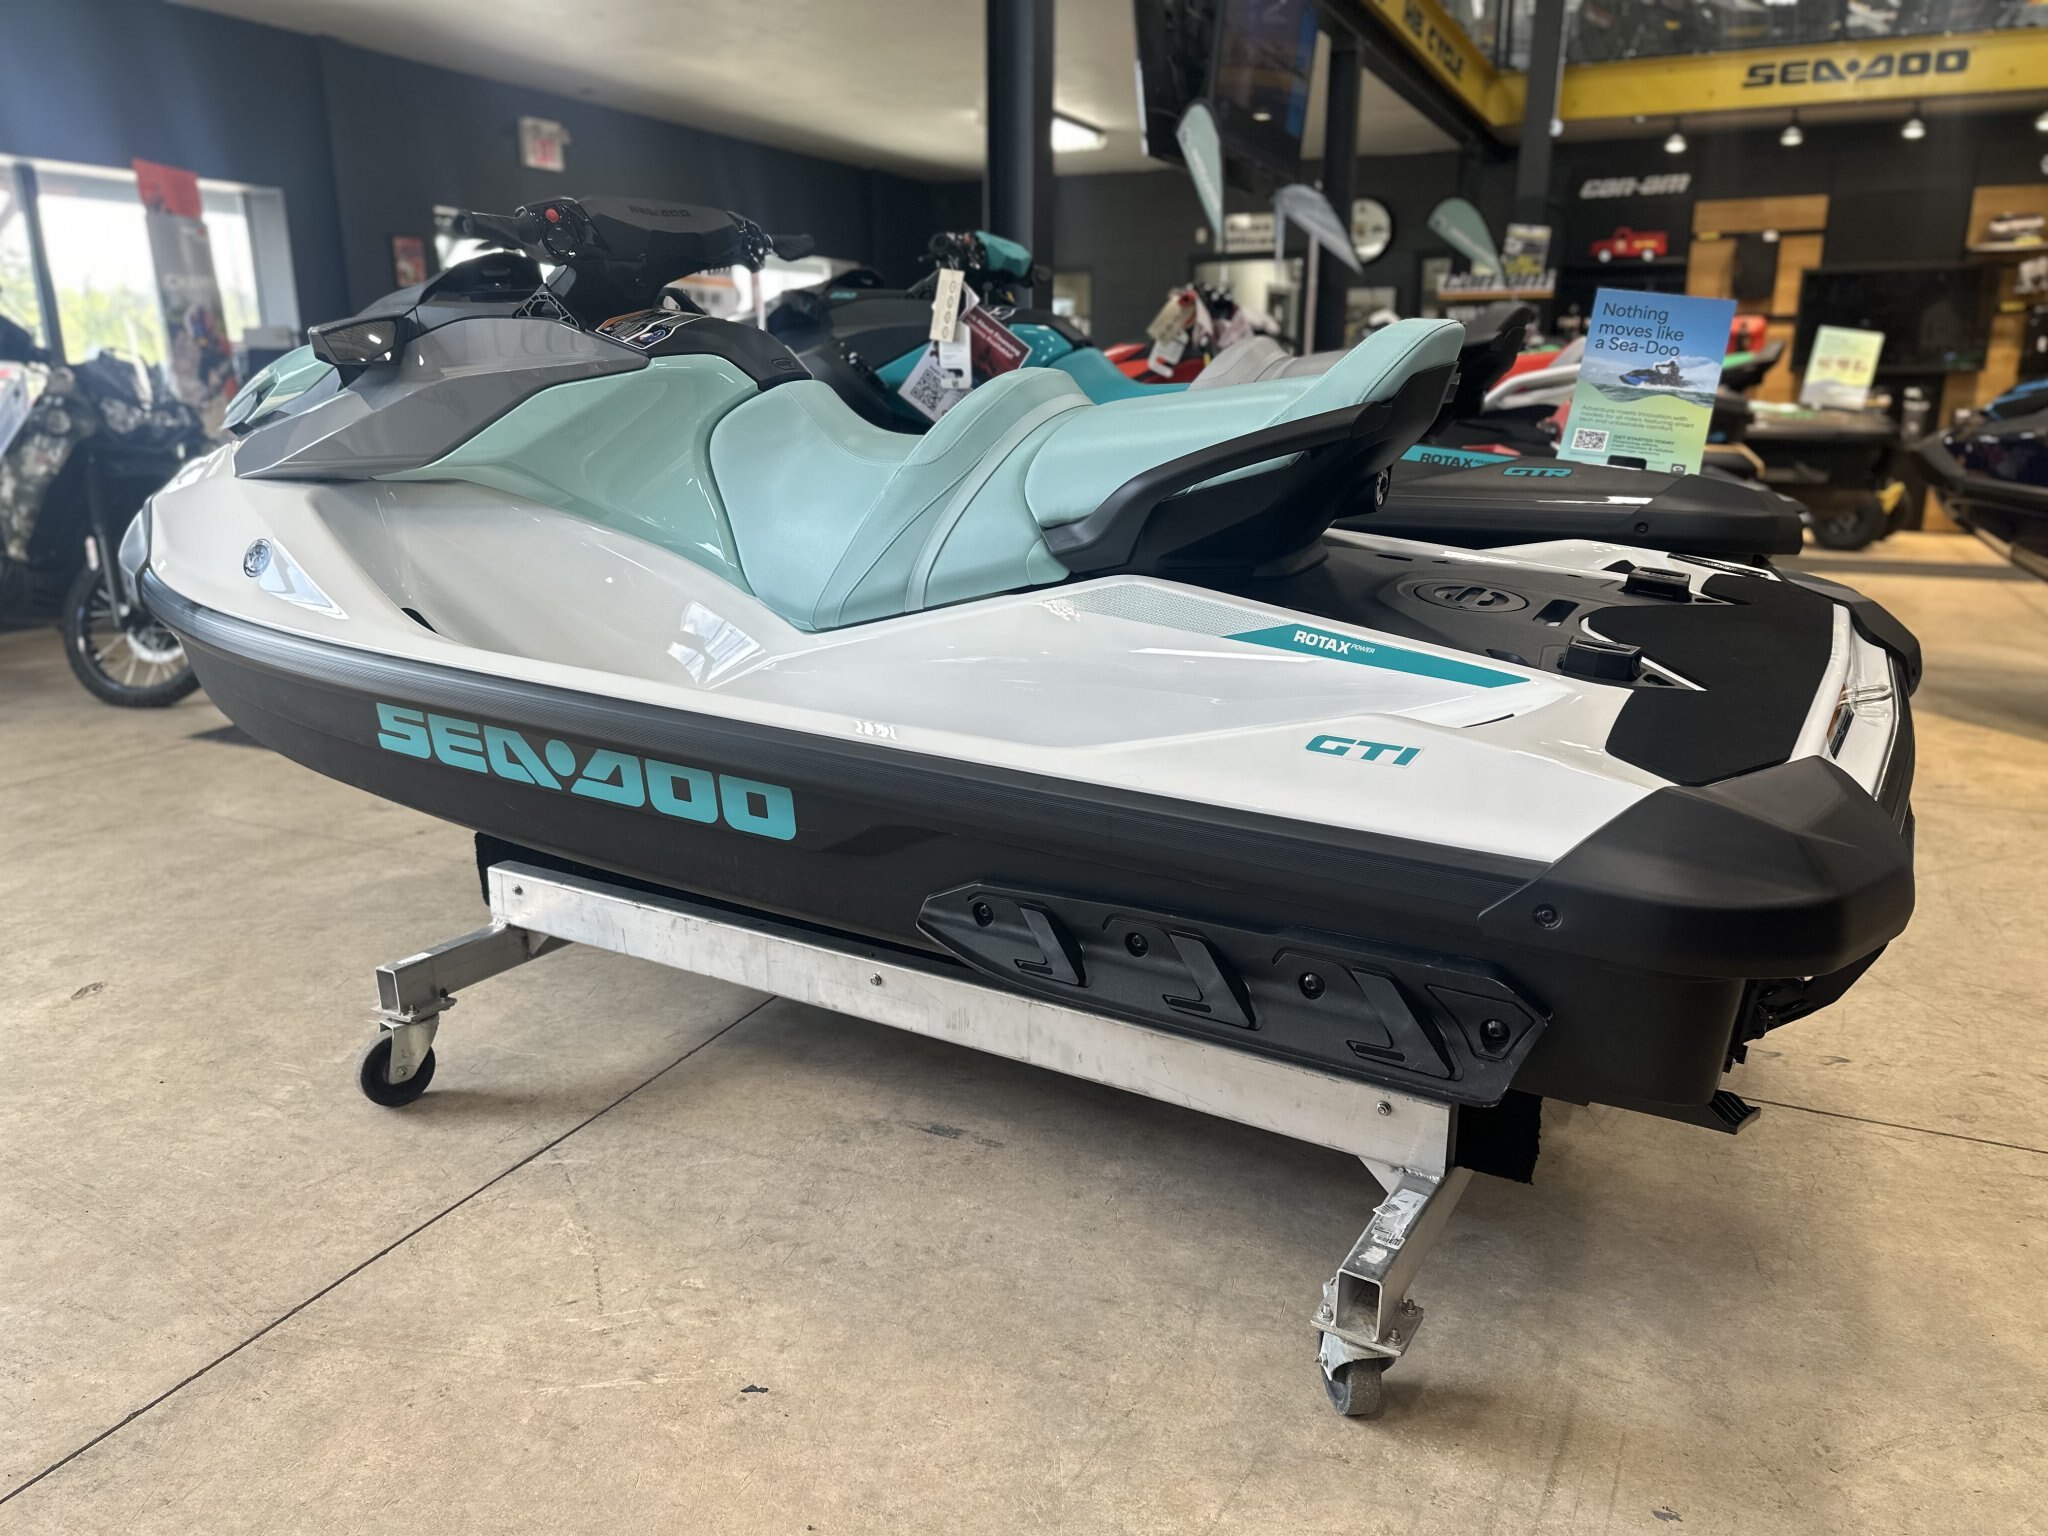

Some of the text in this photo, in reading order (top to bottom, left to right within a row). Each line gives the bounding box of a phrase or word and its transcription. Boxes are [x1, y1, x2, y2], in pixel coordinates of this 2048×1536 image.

[1603, 302, 1669, 324] Nothing
[1599, 323, 1684, 341] moves like
[1595, 337, 1680, 356] a Sea-Doo
[1582, 405, 1615, 413] Adventure
[1638, 411, 1672, 420] innovation
[1644, 417, 1673, 427] featuring
[1675, 421, 1694, 429] smart
[1420, 453, 1474, 468] ROTAX
[1503, 466, 1573, 478] GTR
[1293, 630, 1376, 655] ROTAX POWER
[1305, 734, 1422, 767] GTI
